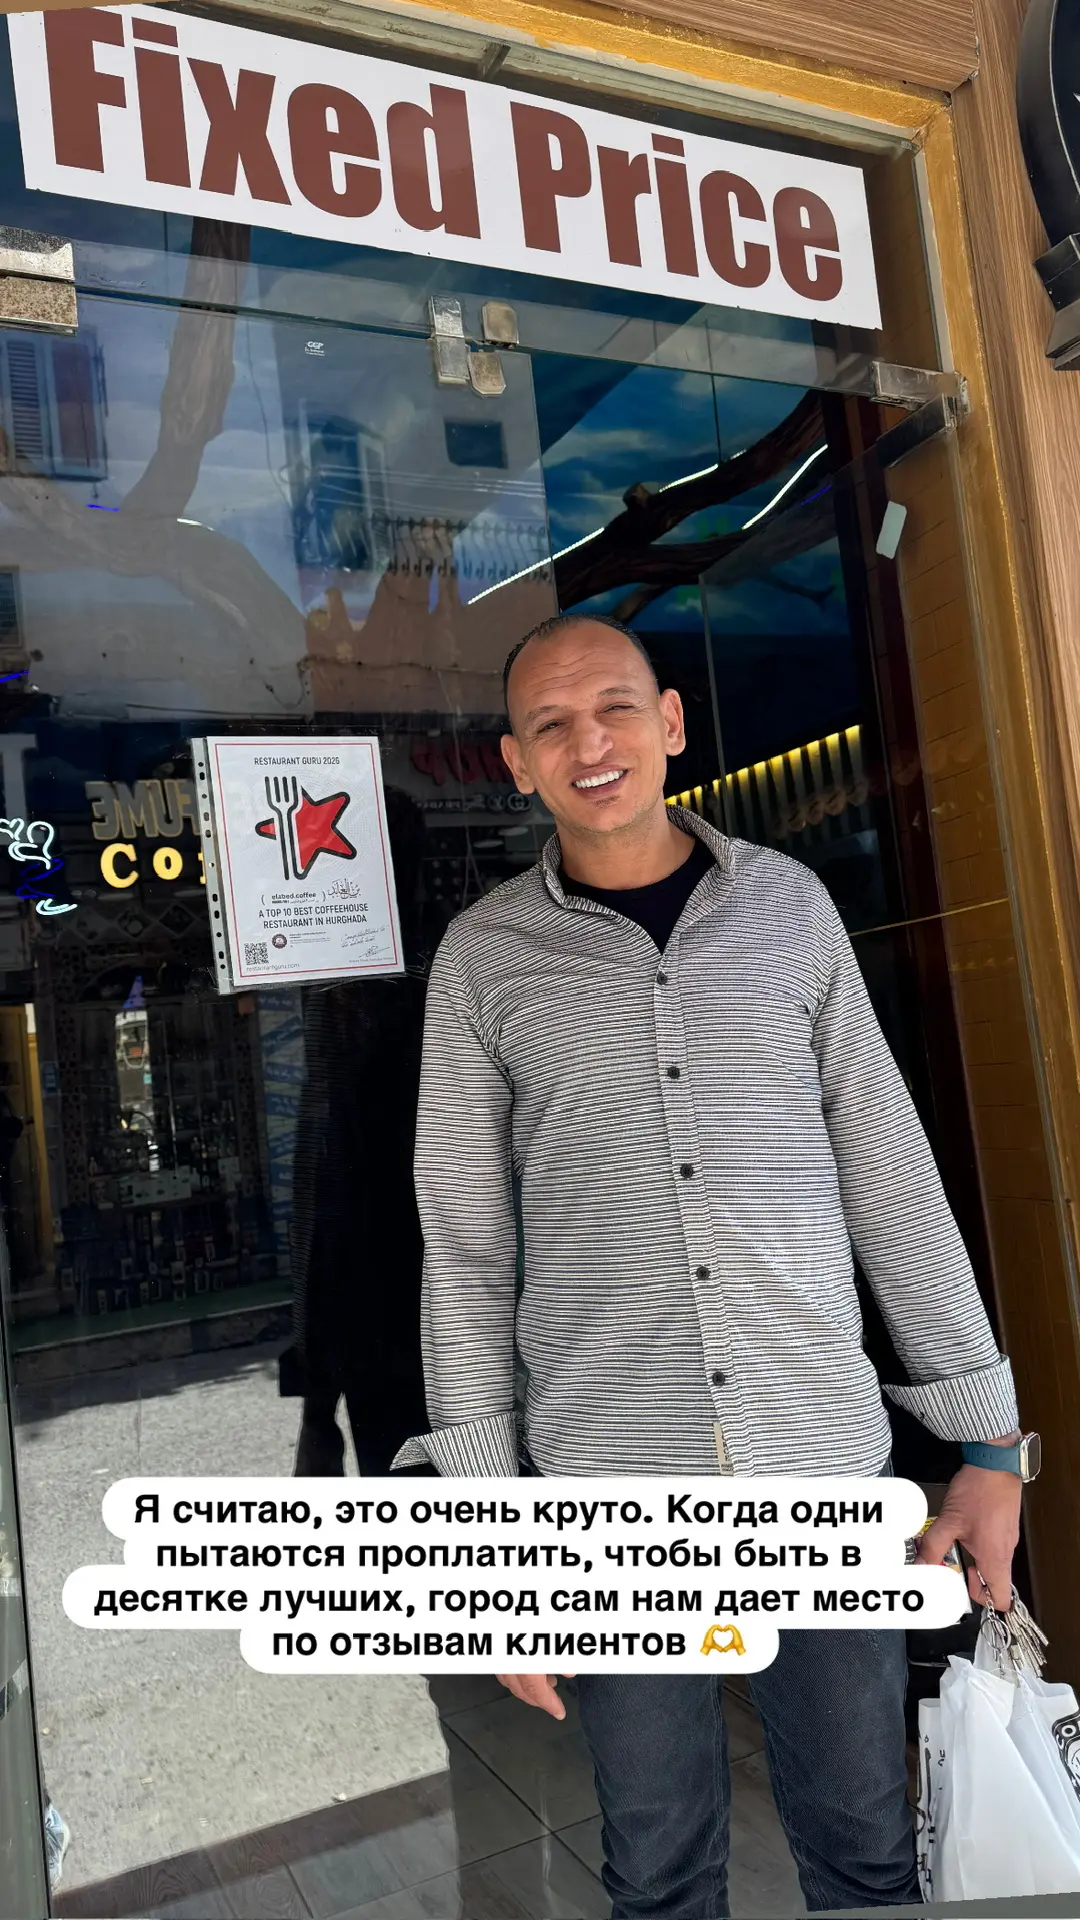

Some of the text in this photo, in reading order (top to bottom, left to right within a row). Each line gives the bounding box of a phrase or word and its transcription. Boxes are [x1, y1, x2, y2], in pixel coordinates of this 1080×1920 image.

[44, 7, 843, 301] Fixed Price
[254, 756, 300, 765] RESTAURANT
[302, 756, 322, 765] GURU
[271, 892, 317, 900] elabed.coffee
[258, 903, 369, 918] A TOP 10 BEST COFFEEHOUSE
[263, 914, 368, 929] RESTAURANT IN HURGHADA
